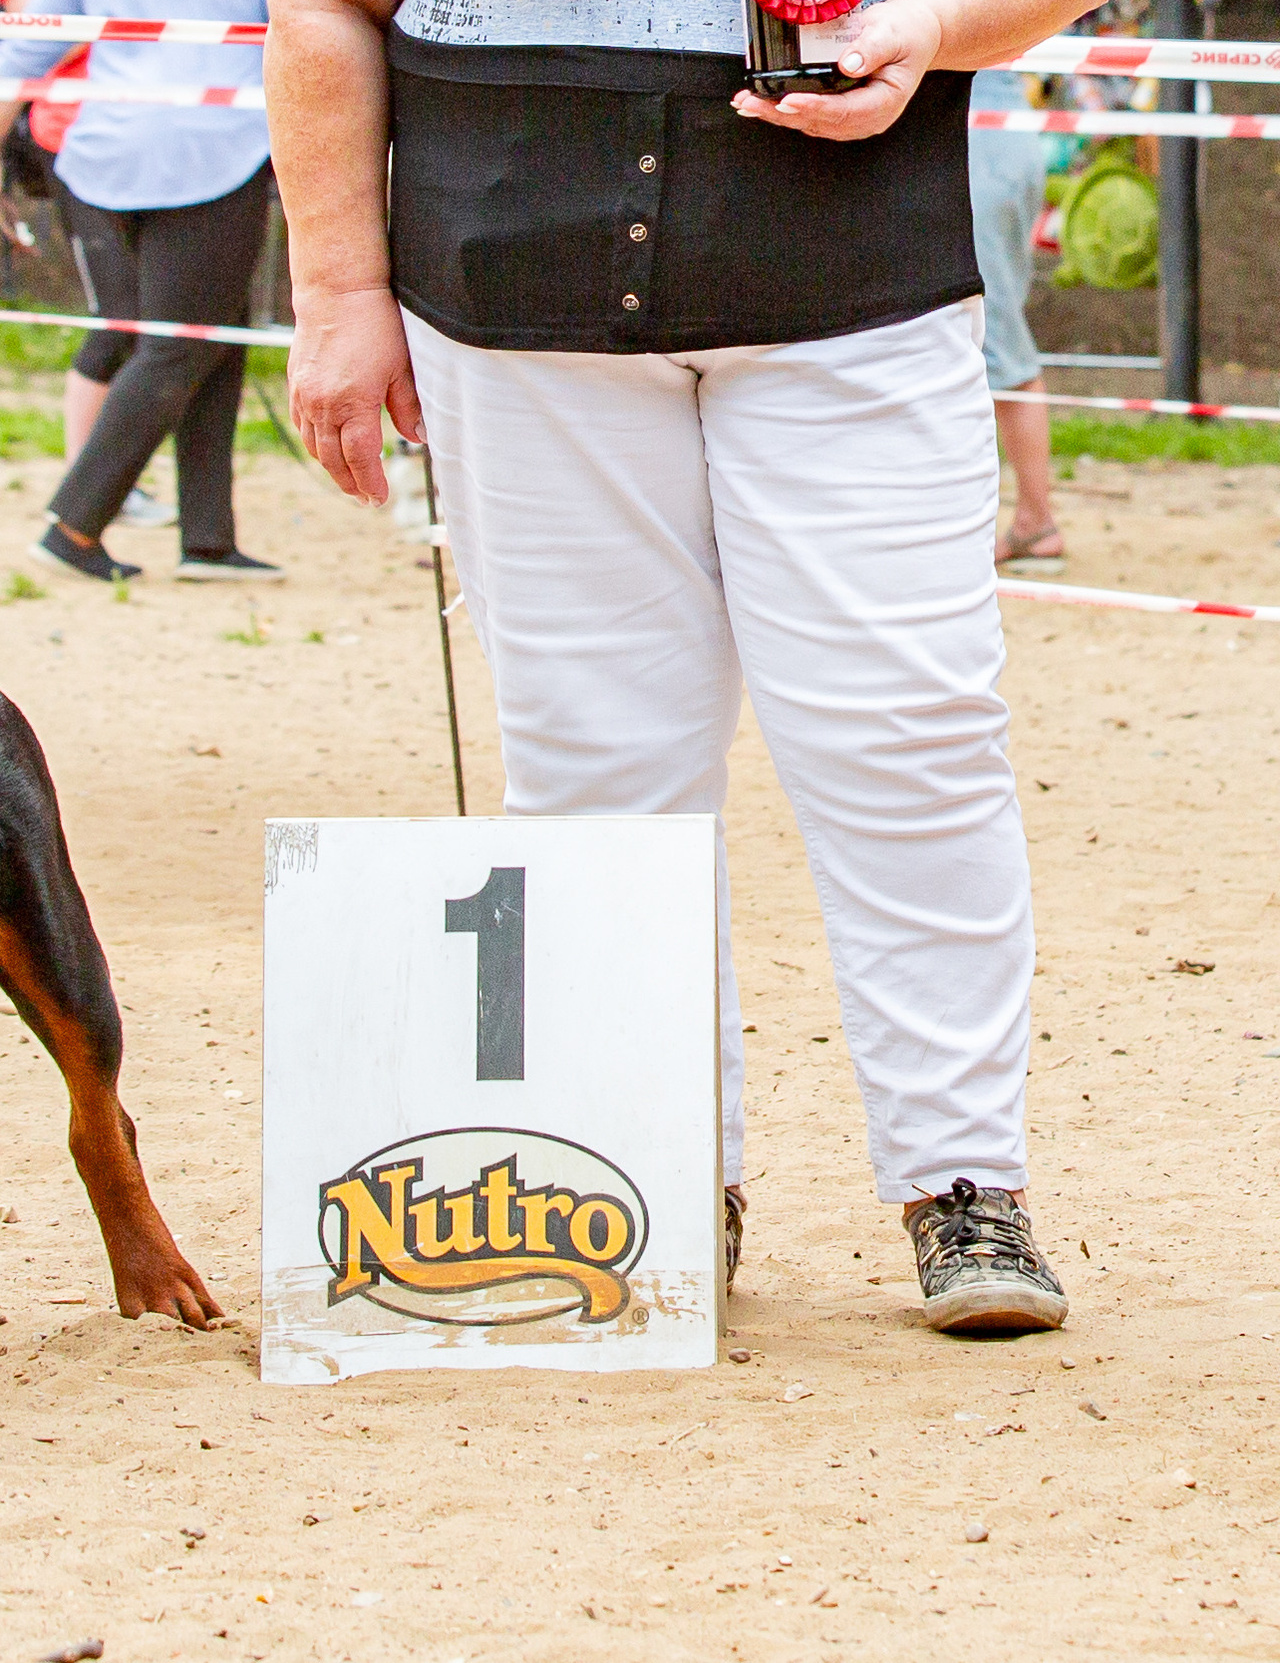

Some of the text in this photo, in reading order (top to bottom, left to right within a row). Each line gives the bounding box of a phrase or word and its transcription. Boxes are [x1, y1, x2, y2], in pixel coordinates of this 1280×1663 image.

[1192, 51, 1261, 65] СЕРВИС
[445, 867, 525, 1081] 1
[320, 1153, 636, 1323] Nutro
